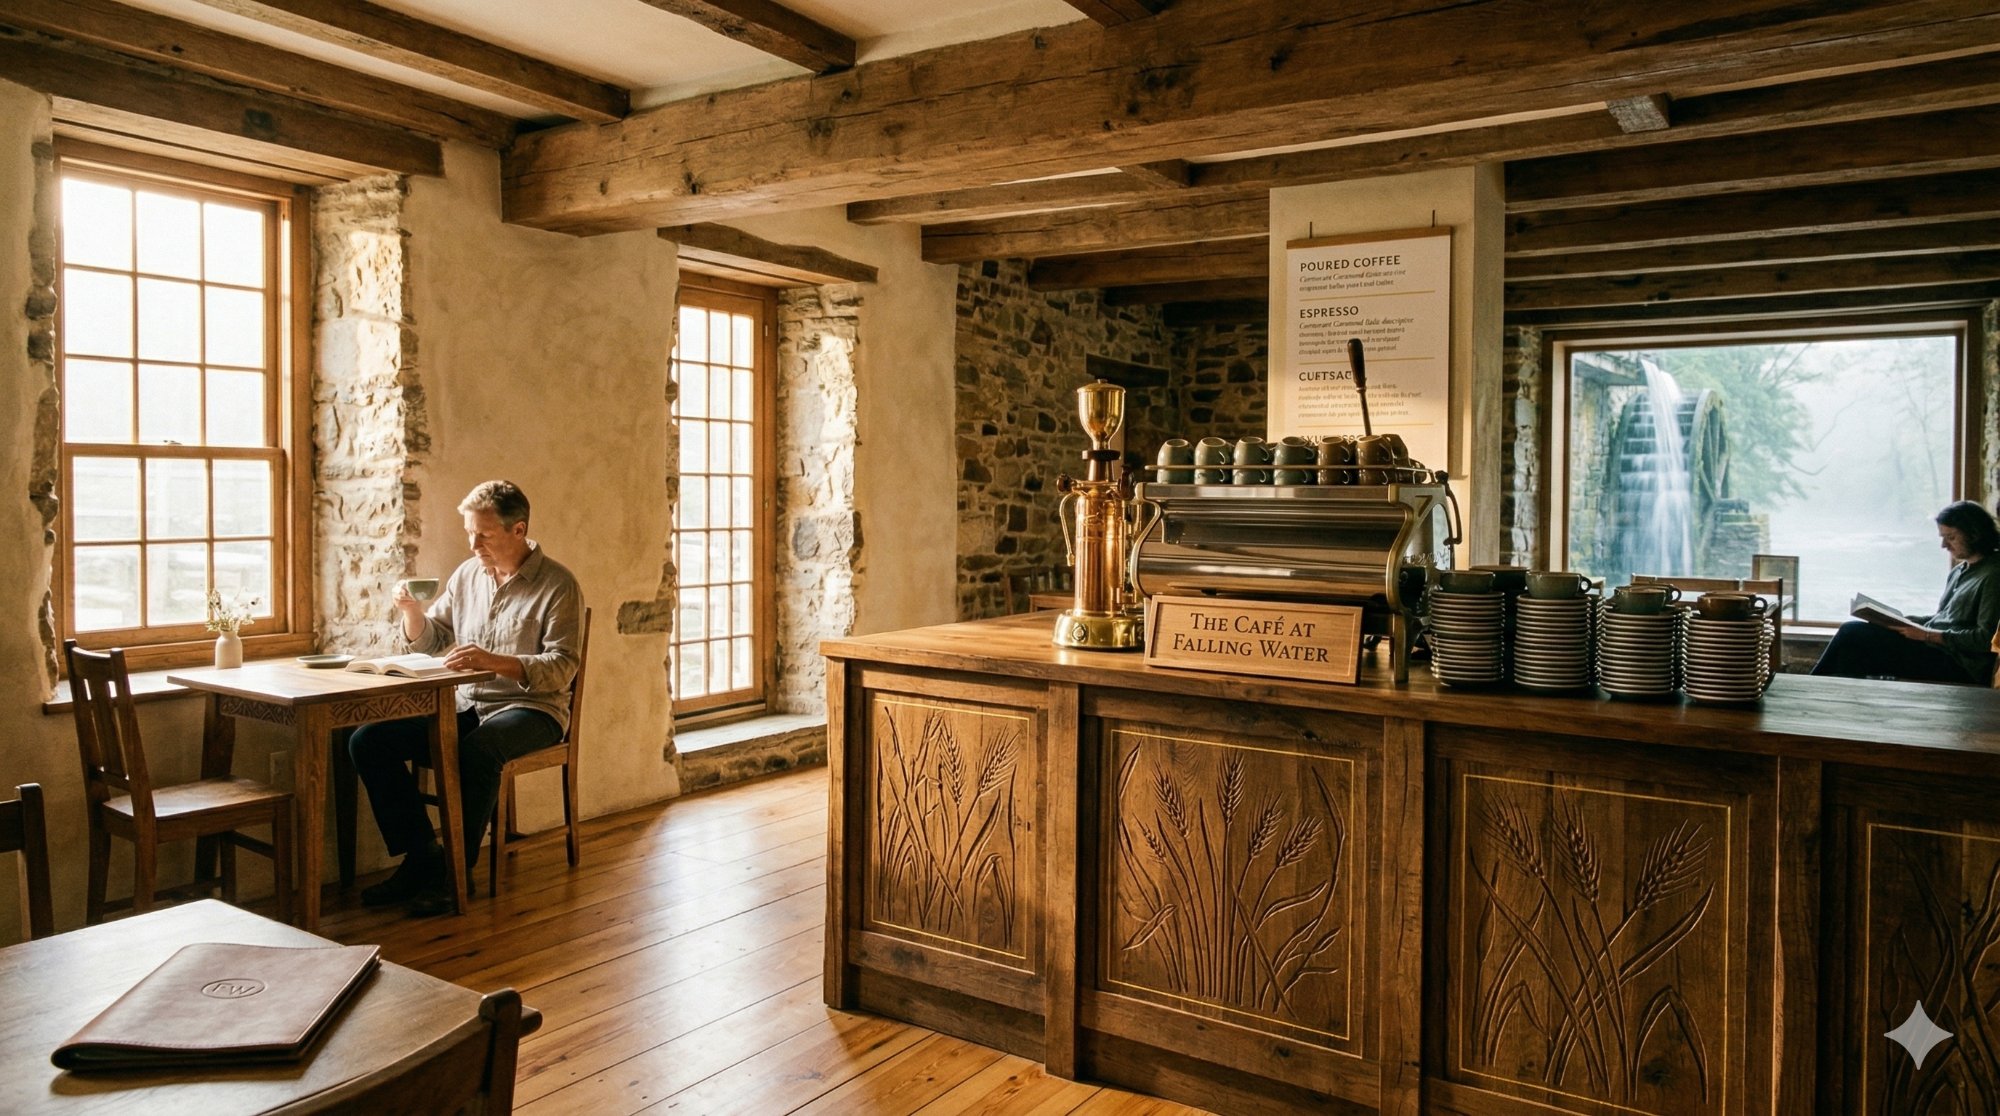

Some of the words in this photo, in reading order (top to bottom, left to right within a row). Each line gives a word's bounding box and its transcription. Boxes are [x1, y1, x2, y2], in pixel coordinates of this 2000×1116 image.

[1300, 259, 1350, 272] POURED
[1353, 255, 1401, 268] COFFEE
[1300, 305, 1359, 319] ESPRESSO
[1190, 612, 1228, 631] THE
[1234, 615, 1284, 636] CAFÉ
[1288, 622, 1316, 638] AT
[1172, 633, 1252, 656] FALLING
[1259, 640, 1329, 663] WATER
[212, 982, 256, 995] FW
